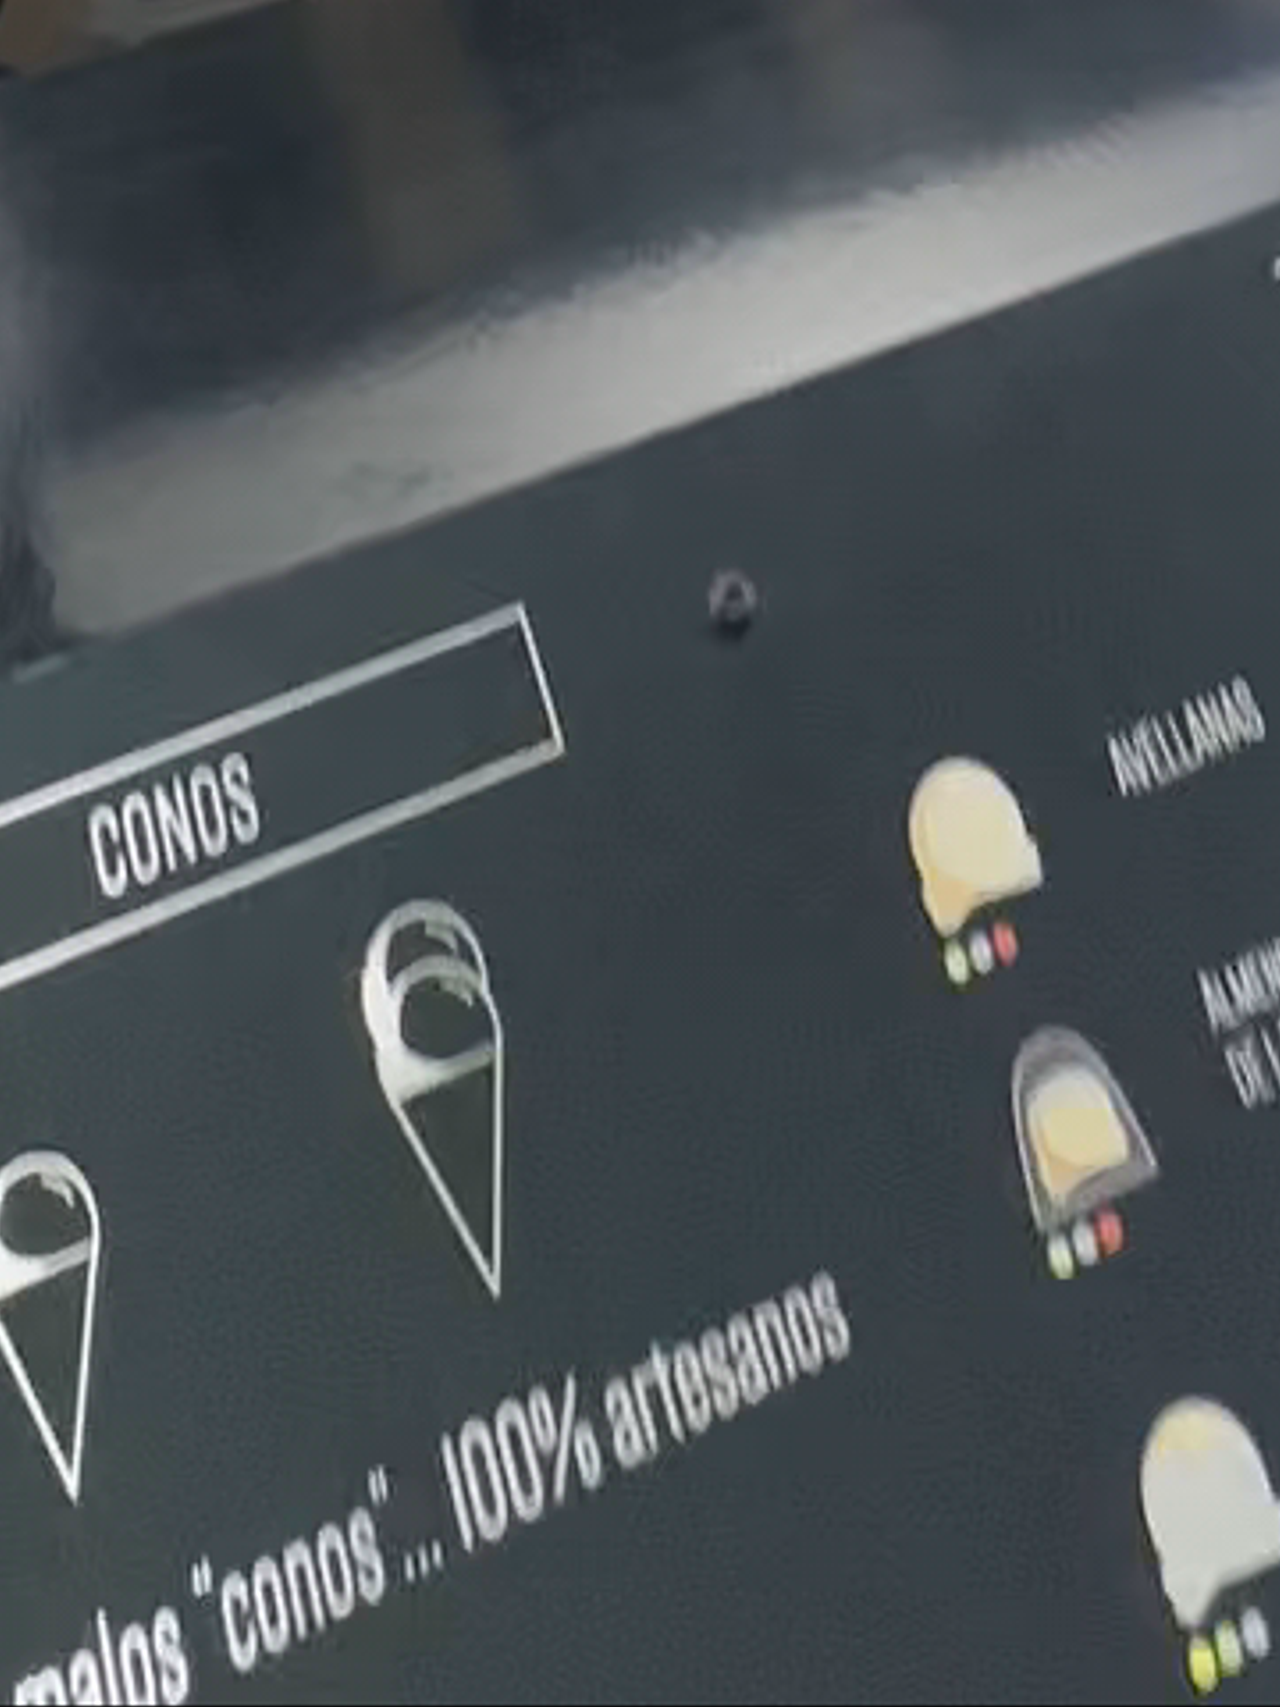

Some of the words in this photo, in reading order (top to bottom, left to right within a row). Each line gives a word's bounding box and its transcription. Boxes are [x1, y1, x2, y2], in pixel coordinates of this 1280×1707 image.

[1107, 673, 1267, 798] AVELLANAS
[88, 750, 260, 900] CONOS
[440, 1372, 602, 1554] 100%
[602, 1270, 851, 1472] artesanos
